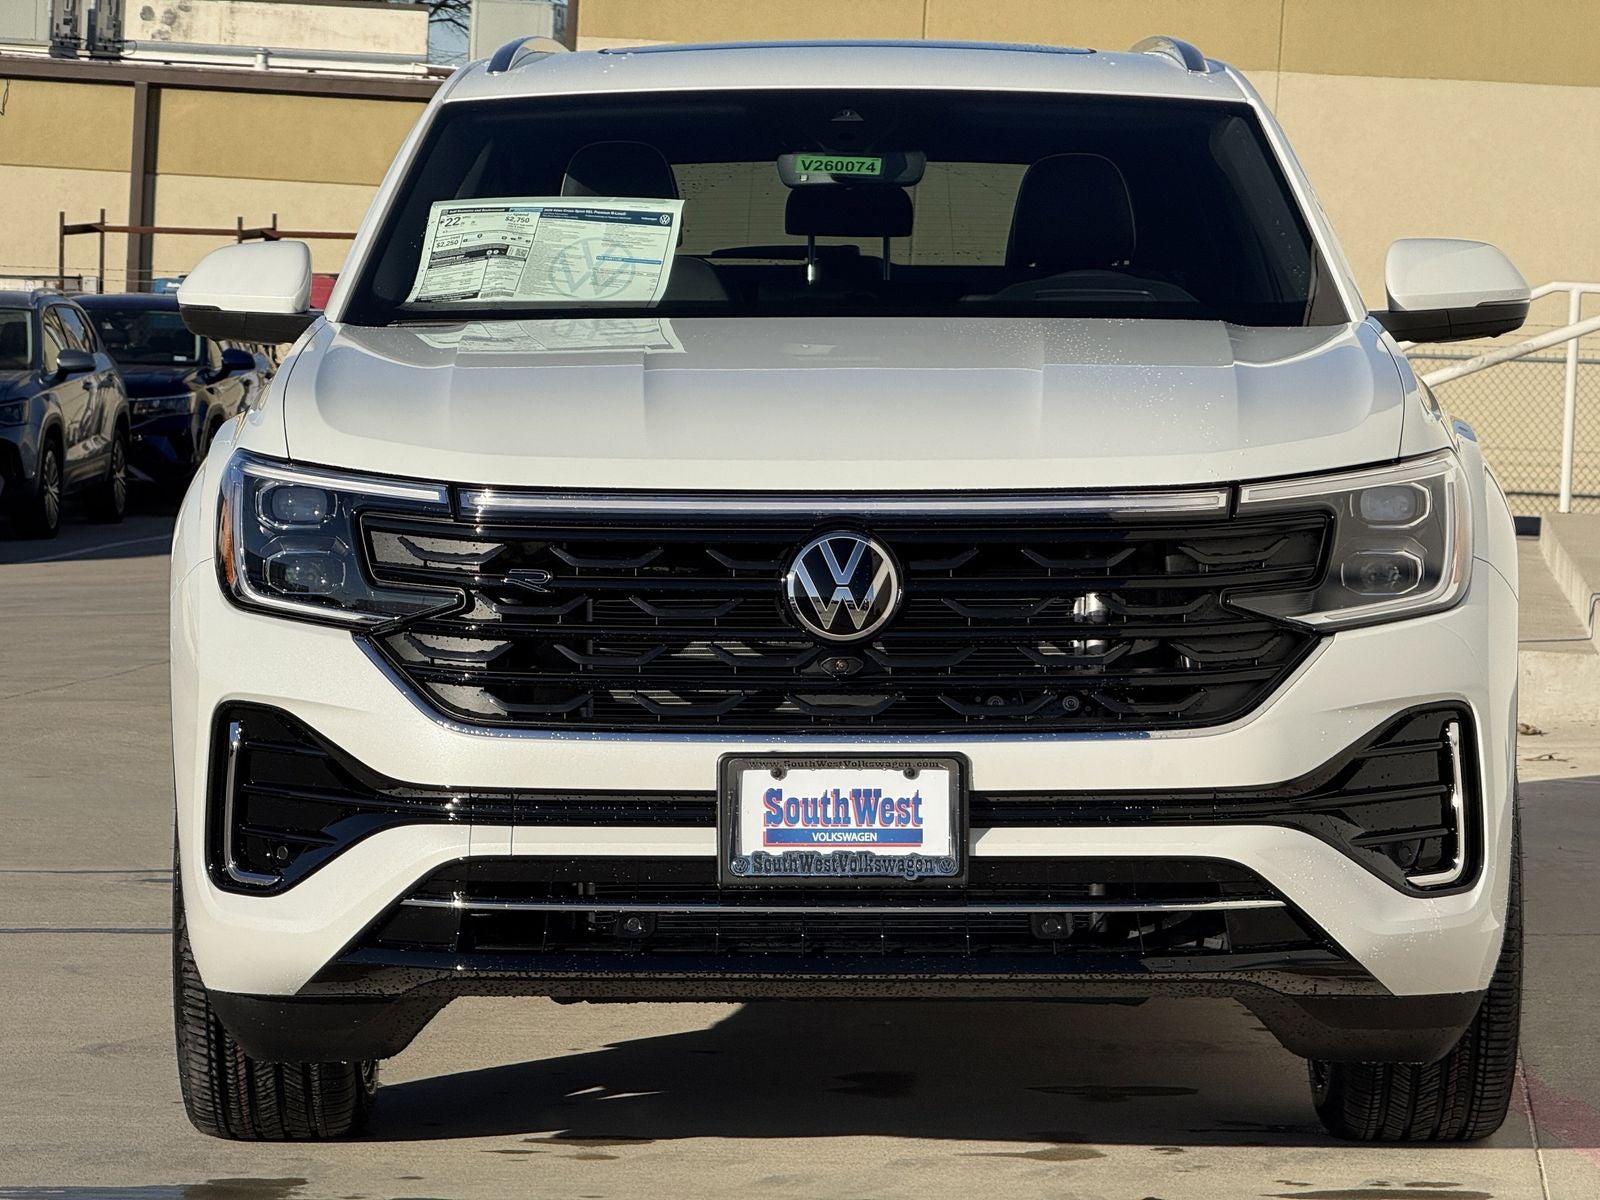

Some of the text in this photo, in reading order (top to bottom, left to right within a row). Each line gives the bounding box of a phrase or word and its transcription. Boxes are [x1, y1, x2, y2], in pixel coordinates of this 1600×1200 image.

[801, 160, 876, 173] V260074
[445, 216, 461, 227] 22
[763, 788, 924, 828] SouthWest
[812, 832, 878, 843] VOLKSWAGEN
[752, 853, 935, 877] SouthWestVolkswagen
